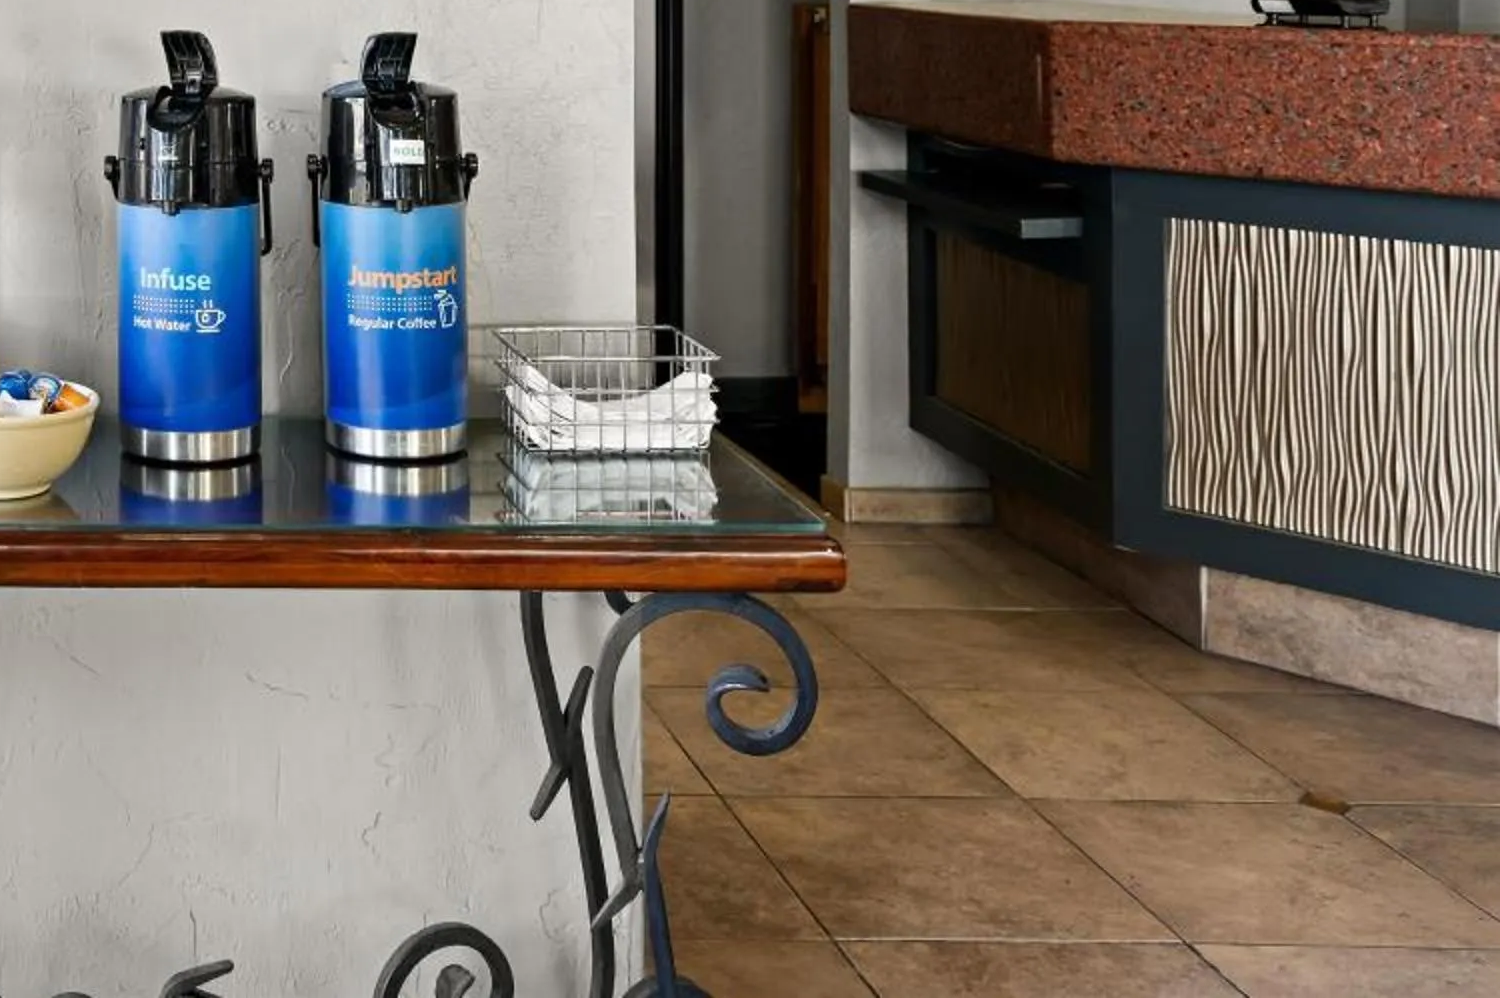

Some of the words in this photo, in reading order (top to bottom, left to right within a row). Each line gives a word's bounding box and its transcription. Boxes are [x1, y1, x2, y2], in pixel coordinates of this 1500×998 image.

[141, 267, 211, 291] Infuse
[348, 265, 457, 295] Jumpstart
[133, 314, 152, 329] Hot
[155, 318, 191, 331] Water
[348, 313, 394, 330] Regular
[397, 317, 437, 329] Coffee
